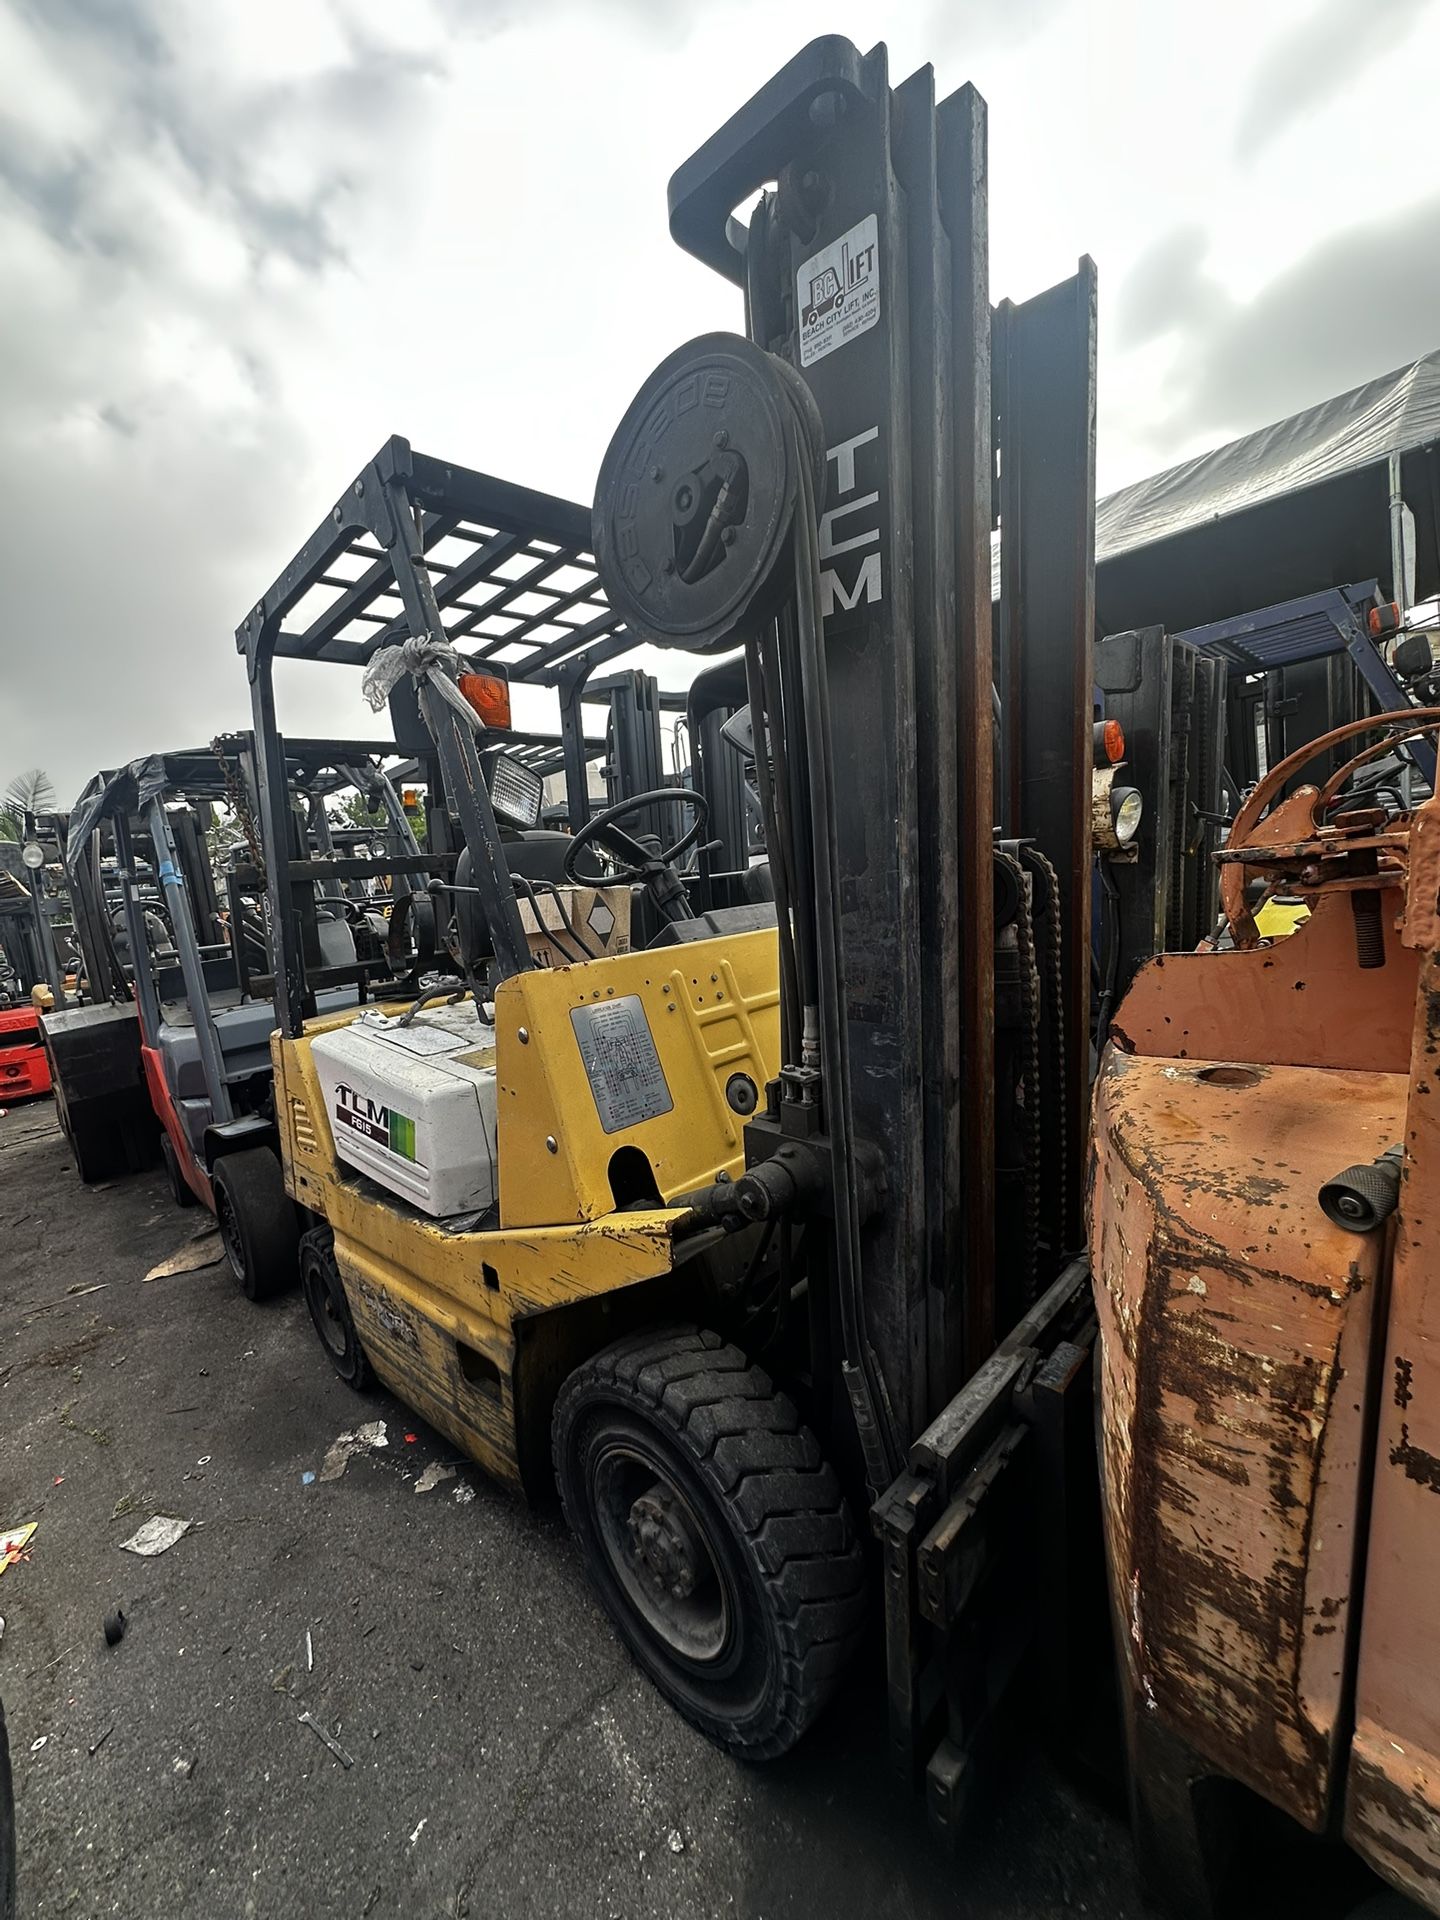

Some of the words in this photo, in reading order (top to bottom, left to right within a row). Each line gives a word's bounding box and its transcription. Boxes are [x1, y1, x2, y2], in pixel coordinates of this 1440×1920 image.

[842, 242, 875, 296] LIFT
[802, 321, 825, 341] BEACH
[826, 309, 842, 325] CITY
[818, 426, 882, 617] TCM
[351, 1116, 372, 1135] FG15
